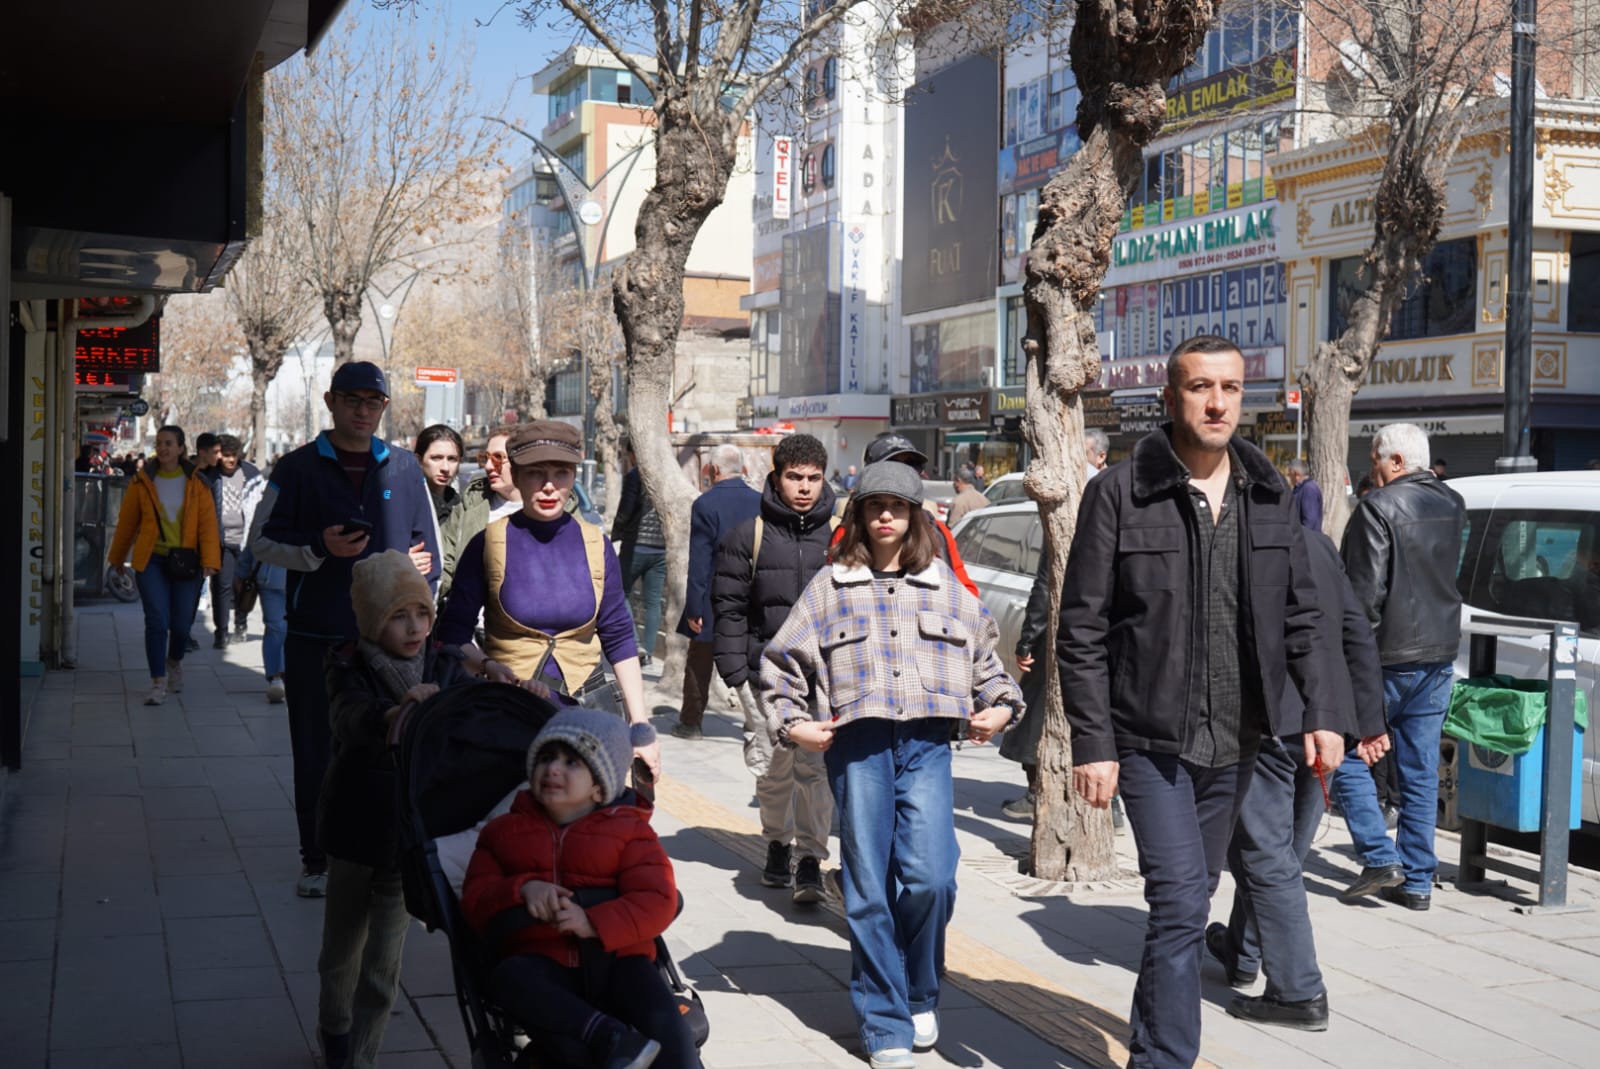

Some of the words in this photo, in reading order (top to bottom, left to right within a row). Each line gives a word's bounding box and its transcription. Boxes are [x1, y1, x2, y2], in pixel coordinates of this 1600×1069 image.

[1166, 93, 1188, 119] RA
[1191, 73, 1249, 112] EMLAK
[776, 139, 790, 201] OTEL
[862, 144, 875, 216] ADA
[1114, 224, 1199, 268] ILDIZ-HAN
[1204, 206, 1276, 251] EMLAK
[1328, 196, 1376, 228] ALTI
[850, 248, 860, 303] VAKIF
[1163, 274, 1276, 316] Allianz
[75, 346, 153, 364] ARKET
[849, 313, 859, 391] KATILIM
